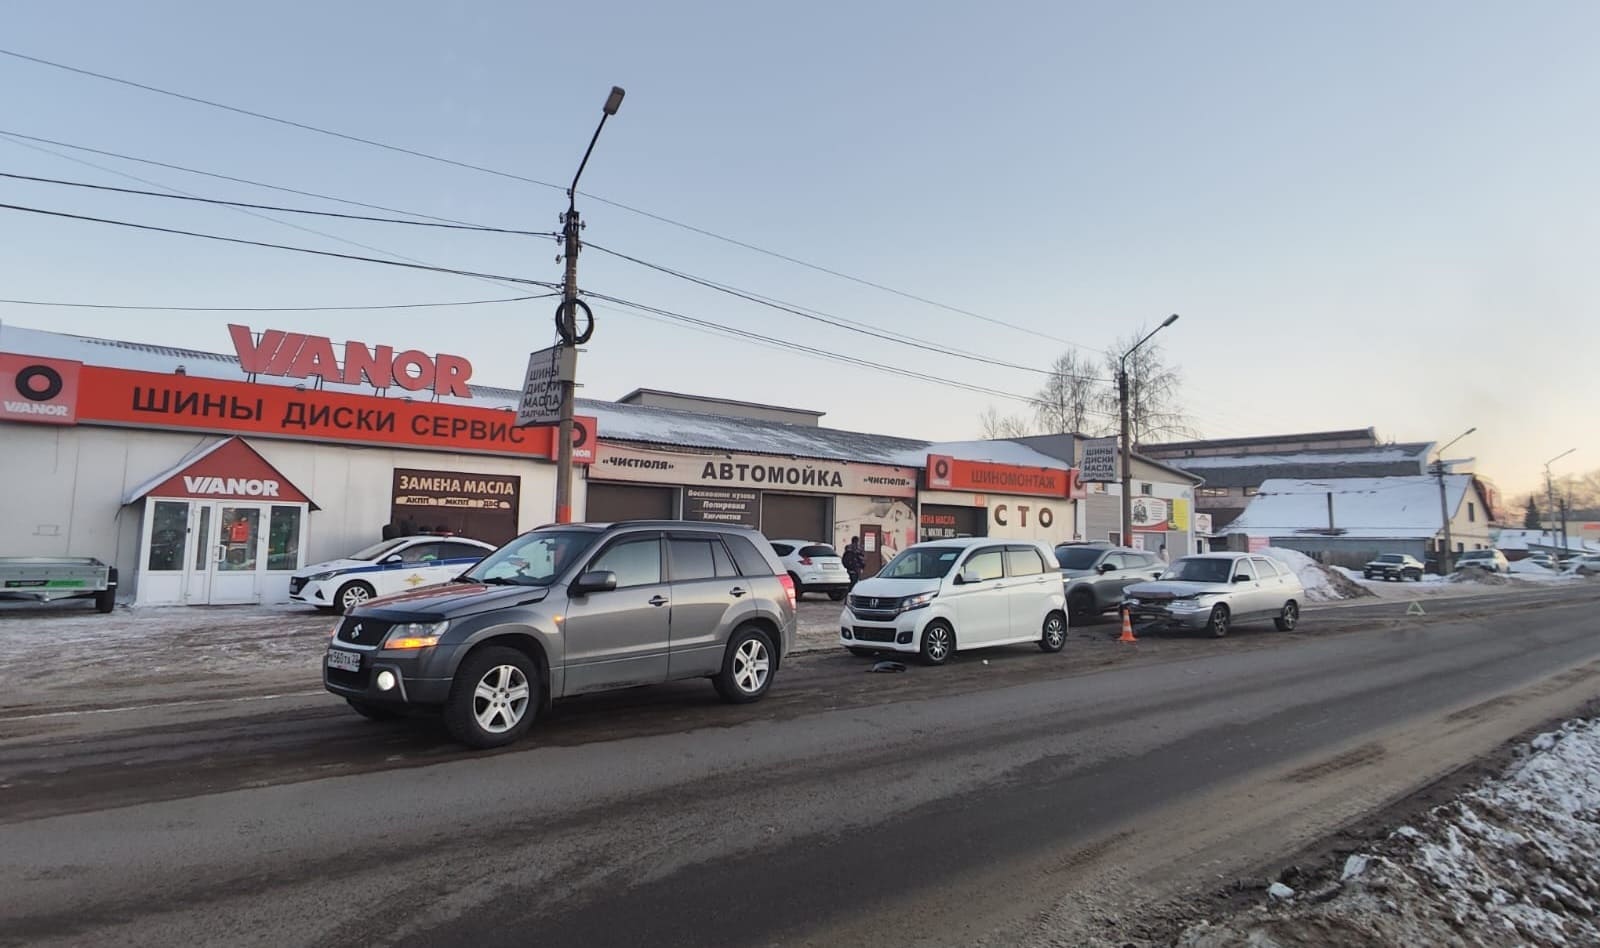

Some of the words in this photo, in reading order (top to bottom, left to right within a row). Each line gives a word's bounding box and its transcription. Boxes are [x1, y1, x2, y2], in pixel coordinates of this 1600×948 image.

[227, 323, 473, 398] VIANOR
[530, 366, 560, 380] ШИНЫ
[526, 382, 560, 396] ДИСКИ
[3, 400, 69, 417] VIANOR
[522, 394, 560, 409] МАСЛА
[132, 386, 262, 421] ШИНЫ
[281, 402, 395, 433] ДИСКИ
[411, 414, 525, 444] СЕРВИС
[1084, 455, 1114, 465] ДИСКИ
[1086, 447, 1113, 456] ШИНЫ
[702, 462, 843, 488] АВТОМОЙКА
[1084, 463, 1114, 472] МАСЛА
[183, 475, 279, 497] VIANOR
[400, 475, 461, 493] ЗАМЕНА
[463, 480, 514, 495] МАСЛА
[971, 468, 1056, 489] ШИНОМОНТАЖ
